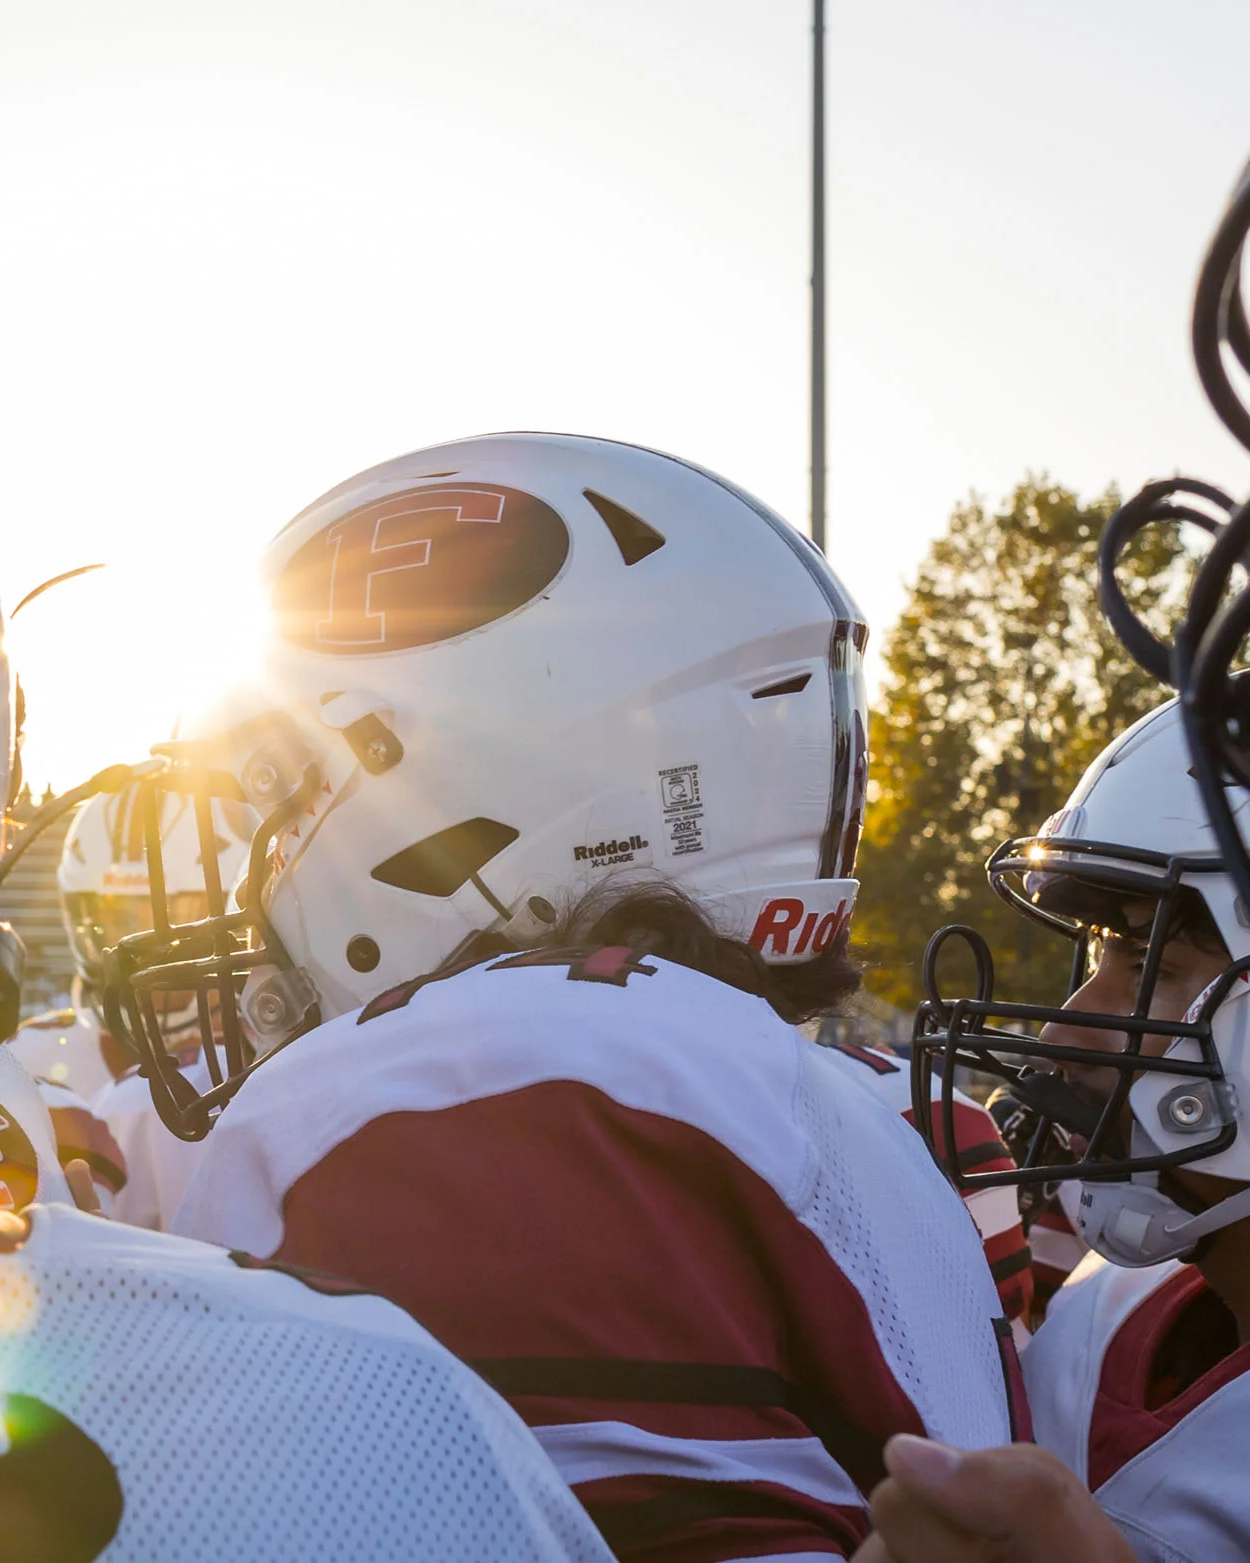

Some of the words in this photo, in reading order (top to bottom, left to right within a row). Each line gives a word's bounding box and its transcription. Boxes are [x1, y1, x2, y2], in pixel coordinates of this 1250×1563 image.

[315, 488, 506, 646] F
[658, 764, 698, 777] RECERTIFIED
[673, 820, 697, 832] 2021
[573, 834, 643, 861] Riddell
[590, 852, 635, 868] X-LARGE
